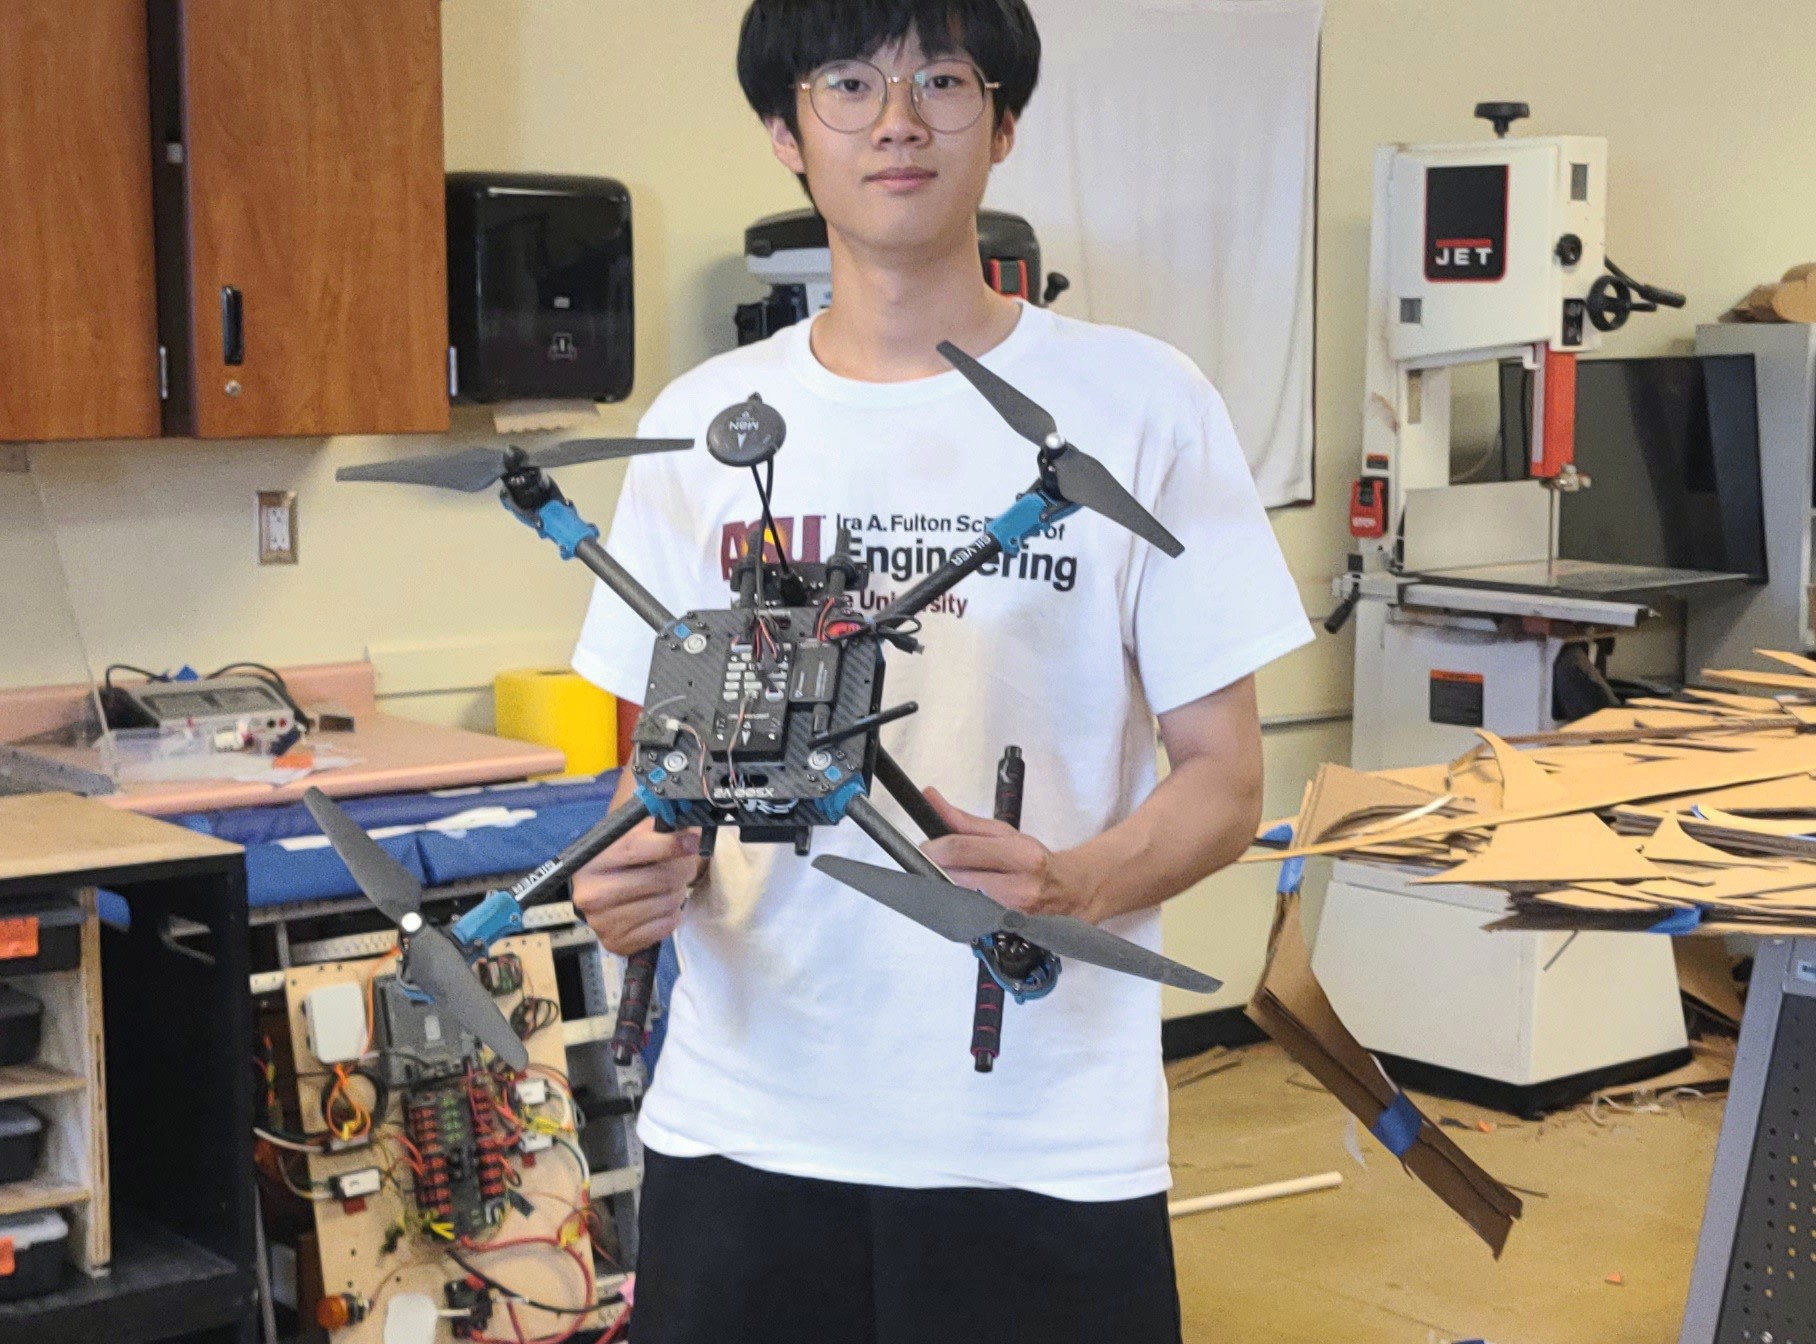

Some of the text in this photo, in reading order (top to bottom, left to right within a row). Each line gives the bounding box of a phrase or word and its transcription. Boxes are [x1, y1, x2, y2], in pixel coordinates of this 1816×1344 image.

[1435, 248, 1493, 266] JET
[837, 513, 863, 531] Ira
[866, 514, 887, 532] A.
[891, 513, 950, 532] Fulton
[1045, 524, 1064, 540] of
[951, 534, 992, 567] SILVER
